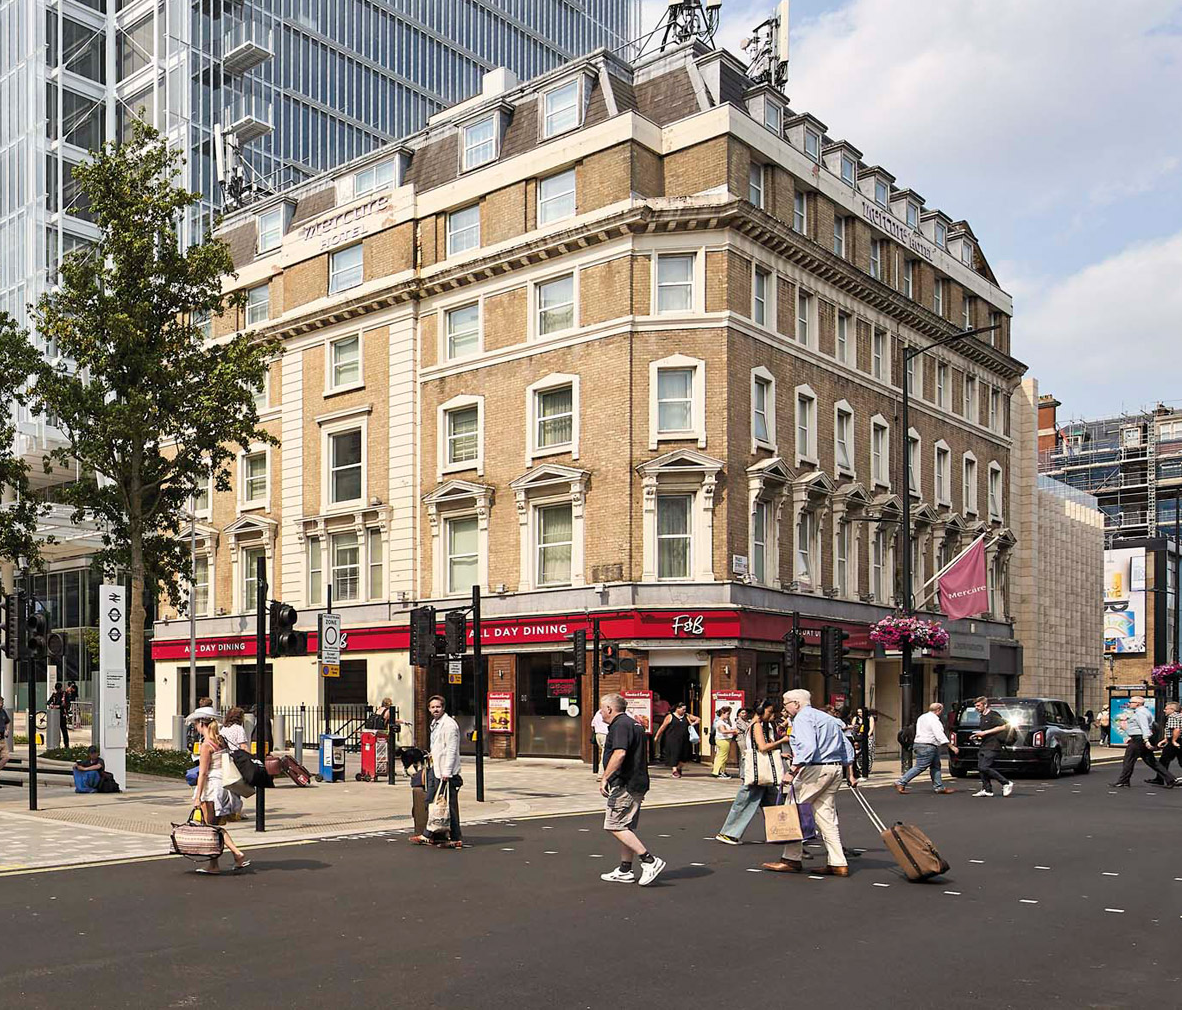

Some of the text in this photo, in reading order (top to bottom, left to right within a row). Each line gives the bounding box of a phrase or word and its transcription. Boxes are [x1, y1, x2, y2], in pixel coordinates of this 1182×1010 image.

[320, 224, 368, 251] HOTEL
[948, 585, 987, 600] Mercure
[494, 627, 519, 637] DAY
[523, 624, 568, 636] DINING
[672, 615, 705, 635] F&B
[200, 644, 216, 652] DAY
[218, 642, 246, 651] DINING
